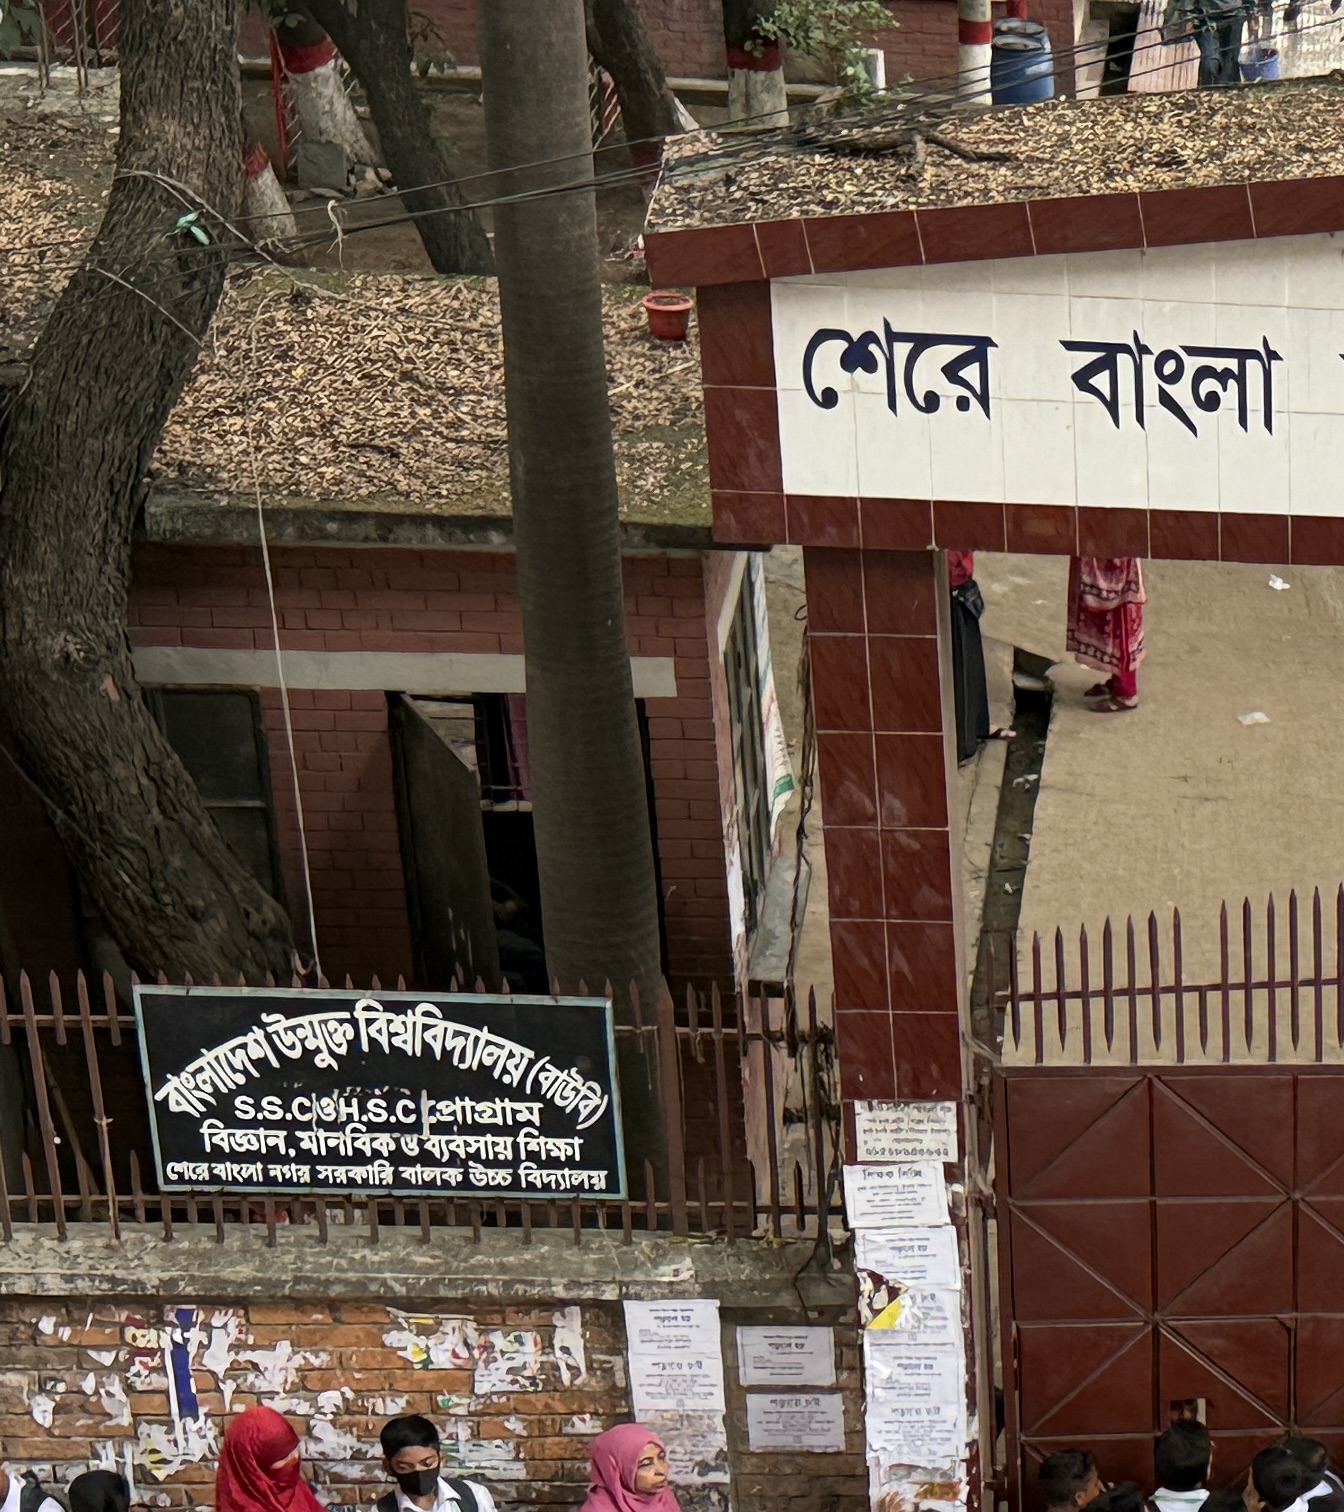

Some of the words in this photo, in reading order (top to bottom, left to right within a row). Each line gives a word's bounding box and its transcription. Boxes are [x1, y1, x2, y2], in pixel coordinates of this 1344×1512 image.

[803, 318, 998, 420] শেরে
[1059, 330, 1283, 438] বাংলা
[154, 1028, 281, 1118] বাংলাদেশ
[261, 1012, 355, 1070] উন্মুক্ত
[354, 998, 536, 1086] বিশ্ববিদ্যালয়
[525, 1055, 609, 1130] (বাউবি)
[234, 1094, 312, 1122] S.S.C
[339, 1095, 417, 1123] H.S.C
[200, 1122, 296, 1158] বিজ্ঞান,
[296, 1125, 395, 1157] মানবিক
[401, 1134, 420, 1156] ও
[424, 1131, 514, 1163] ব্যবসায়
[517, 1131, 584, 1161] শিক্ষা
[317, 1161, 394, 1186] সরকারি
